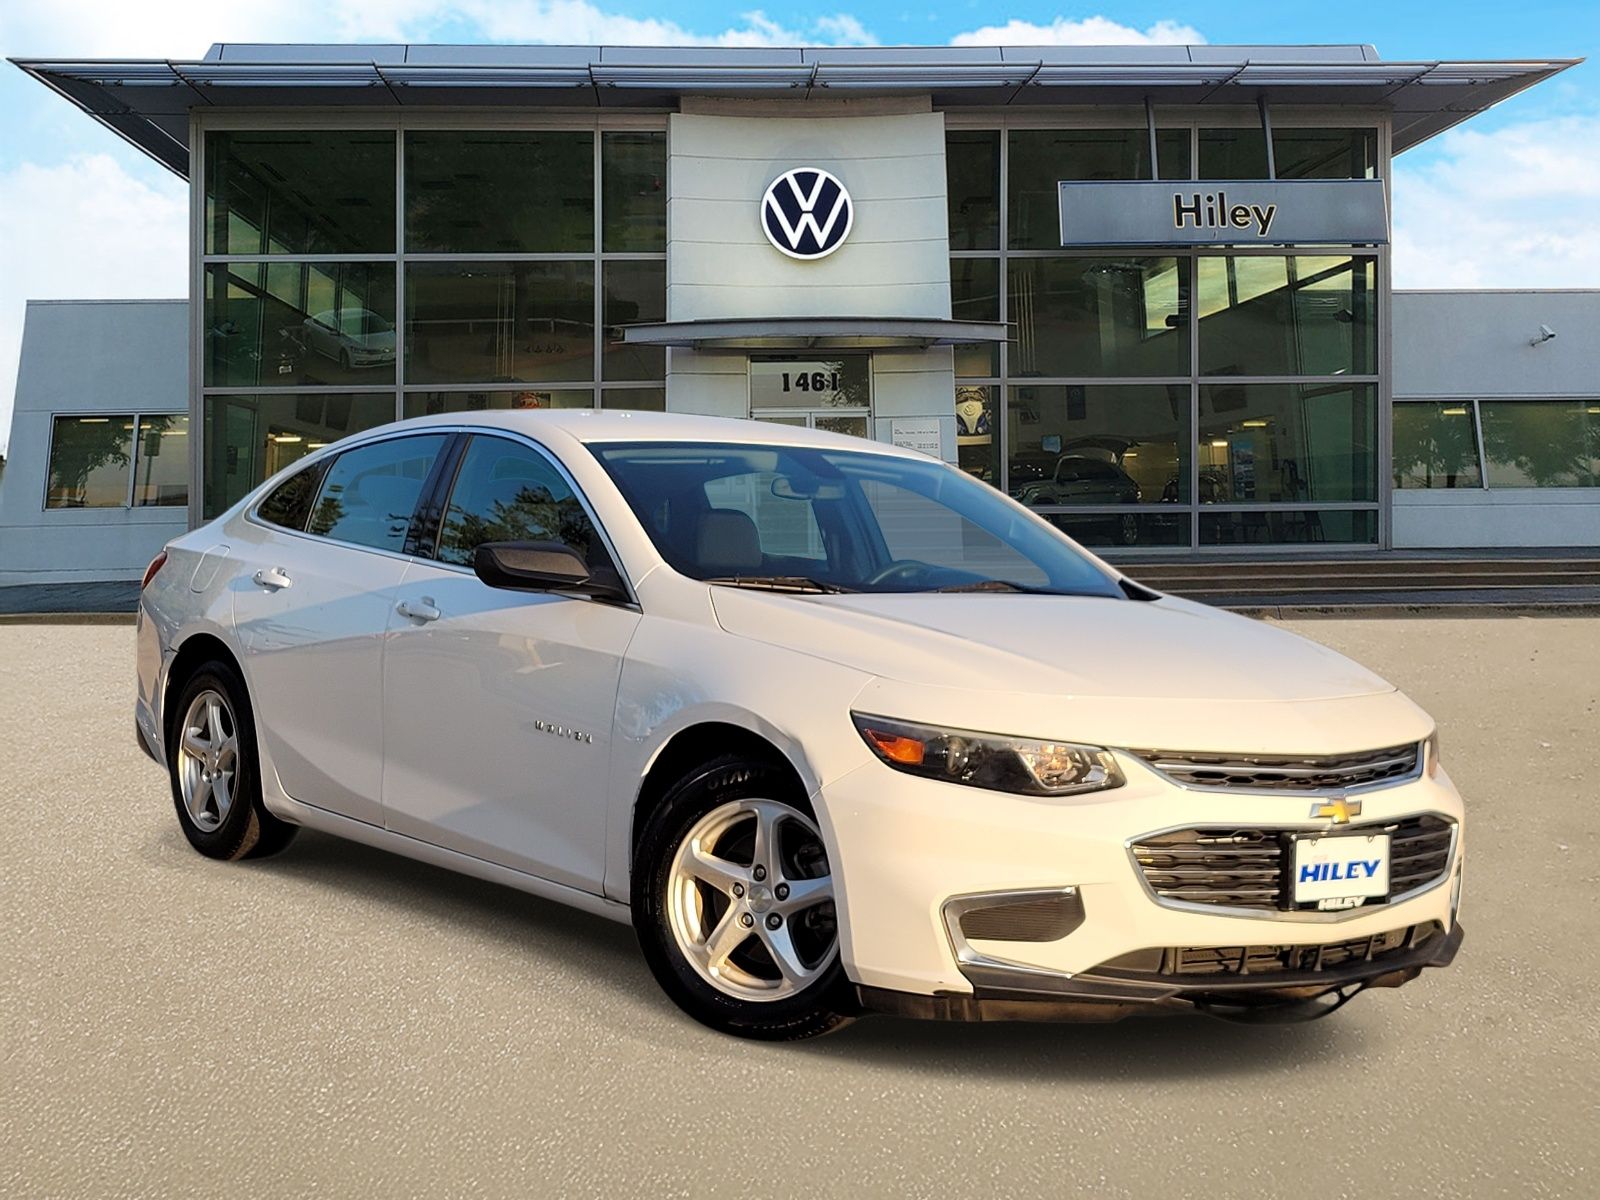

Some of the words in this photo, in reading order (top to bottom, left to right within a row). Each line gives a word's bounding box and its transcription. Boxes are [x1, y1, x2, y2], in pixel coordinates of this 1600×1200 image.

[1173, 191, 1277, 237] Hiley
[781, 371, 839, 392] 1461
[1298, 858, 1382, 883] HILEY
